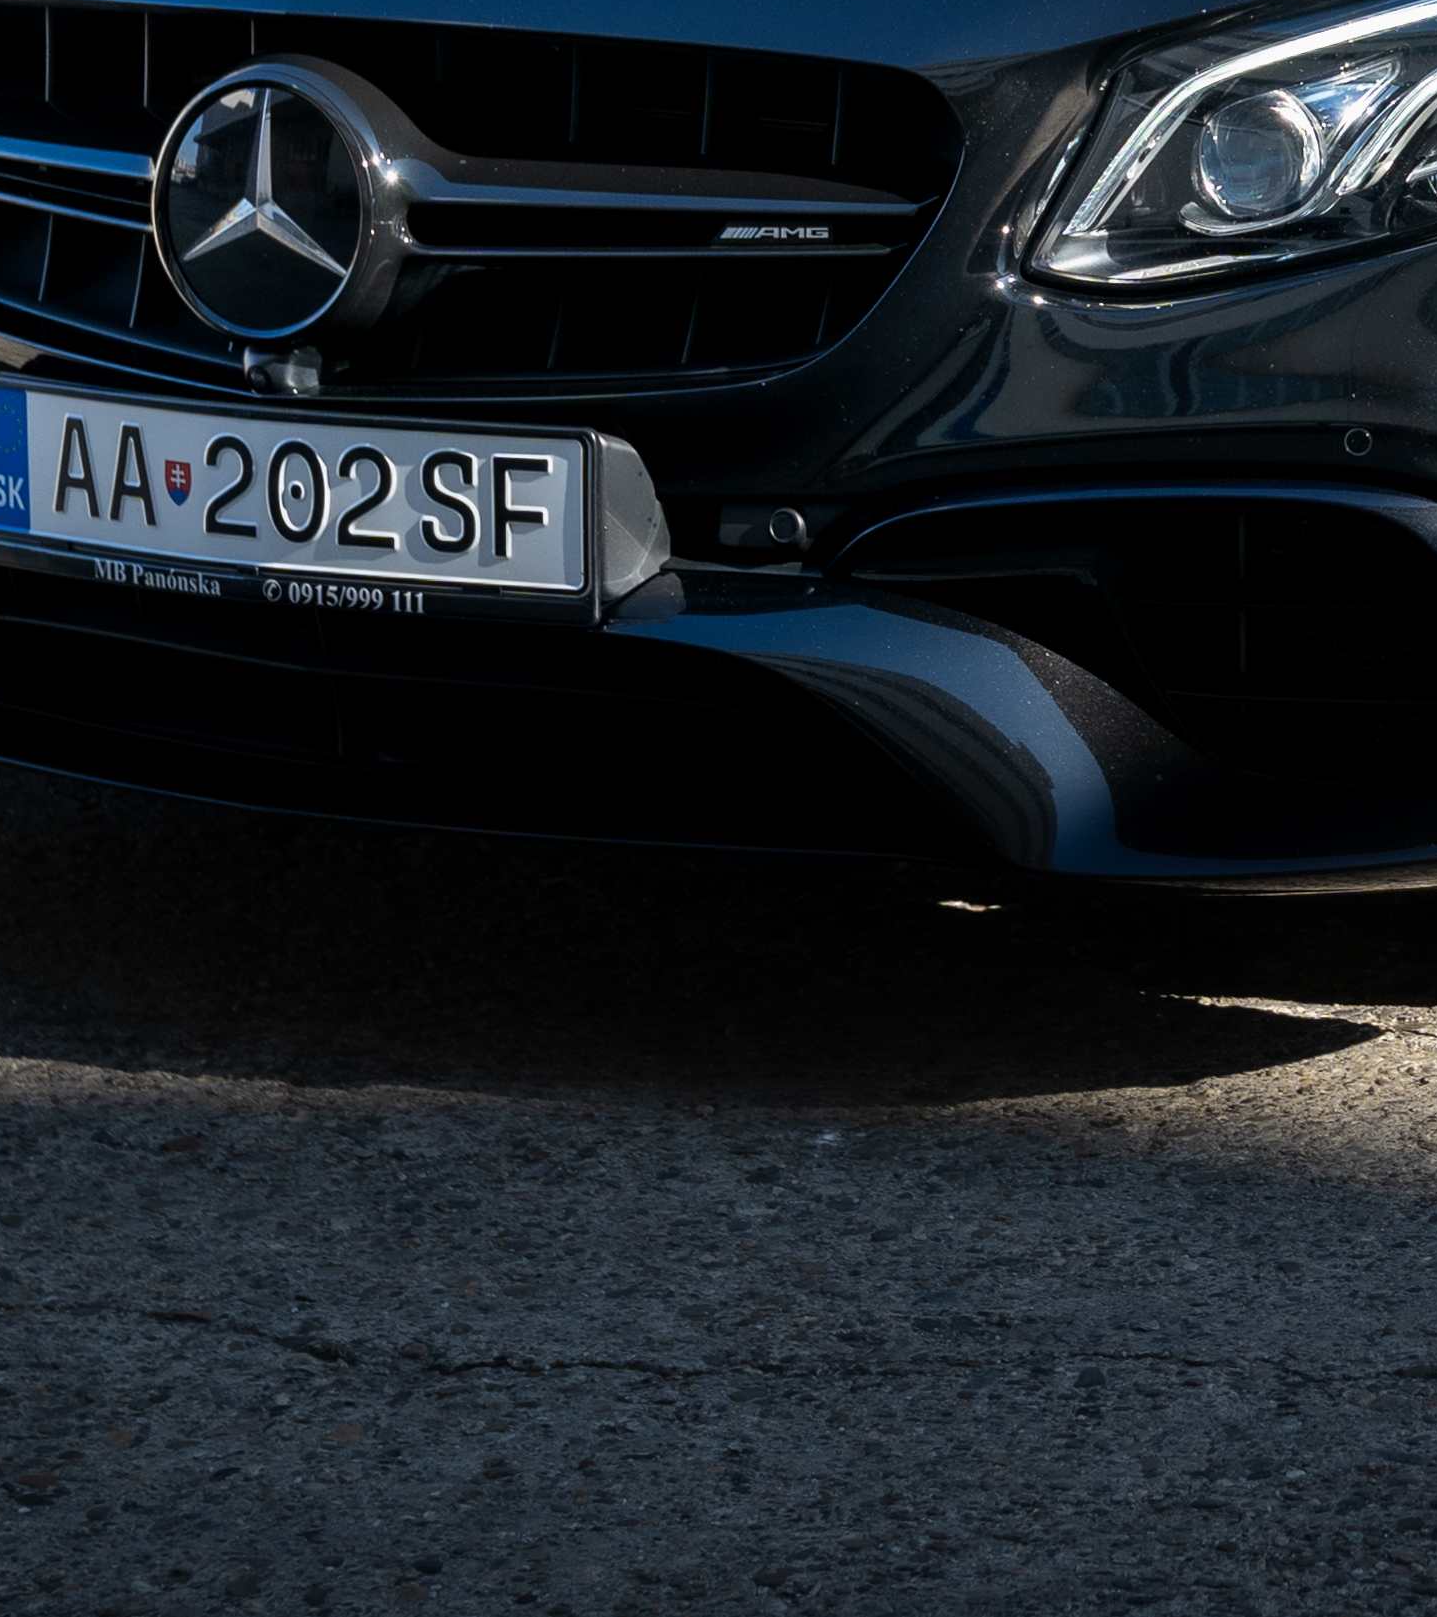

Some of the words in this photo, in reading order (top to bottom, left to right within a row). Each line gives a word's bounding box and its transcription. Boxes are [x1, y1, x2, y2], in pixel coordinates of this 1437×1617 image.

[52, 416, 157, 528] AA
[93, 557, 128, 585] MB
[131, 563, 222, 598] Panónska
[287, 581, 384, 611] 0915/999
[391, 590, 426, 615] 111
